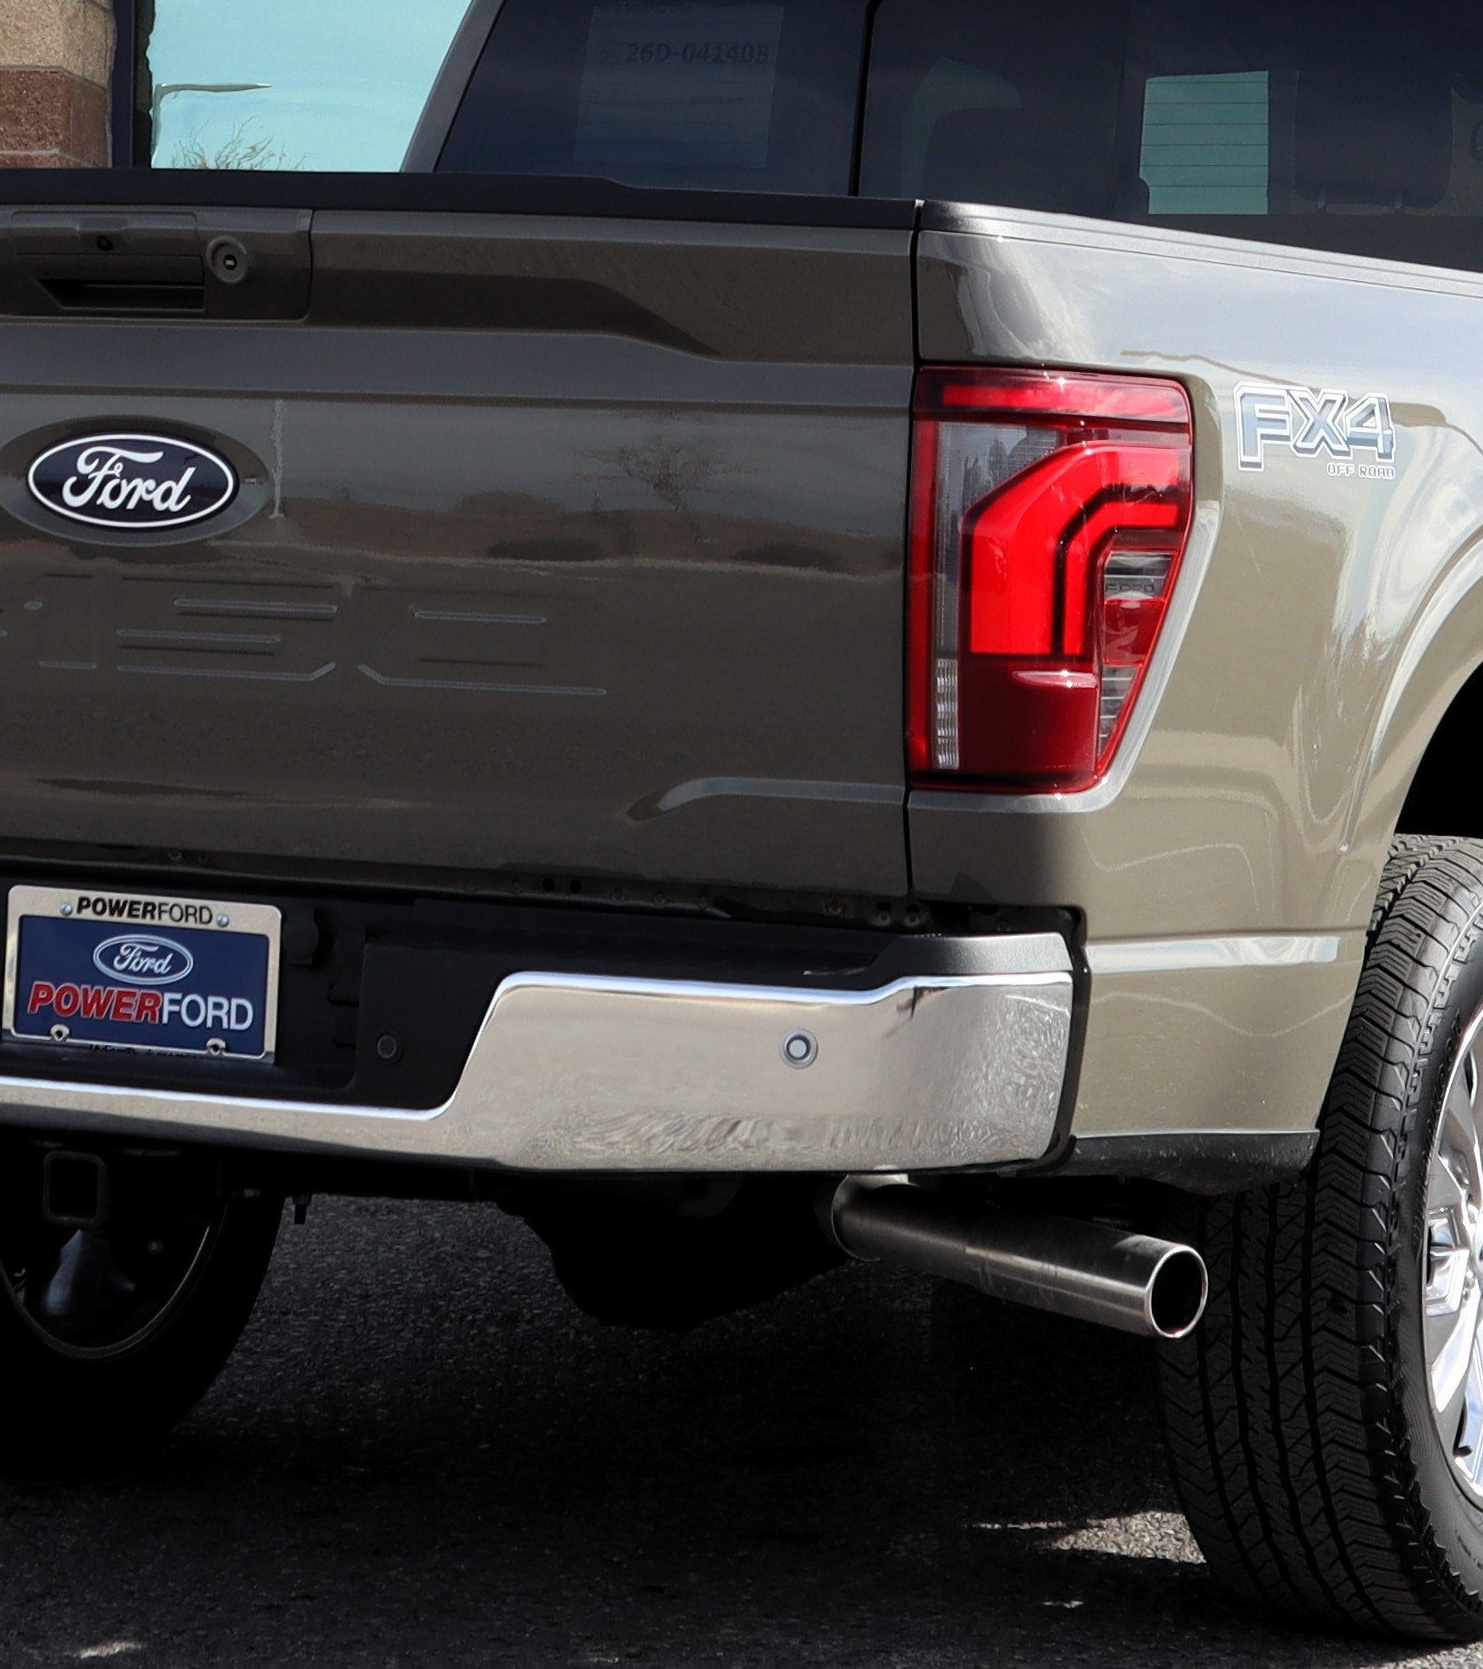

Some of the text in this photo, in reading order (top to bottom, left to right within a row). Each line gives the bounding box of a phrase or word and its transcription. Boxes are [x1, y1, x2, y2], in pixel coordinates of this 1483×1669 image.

[1233, 381, 1396, 472] FX4
[62, 445, 197, 513] Ford
[1327, 461, 1396, 480] OFF ROAD
[76, 896, 214, 925] POWERFORD
[113, 946, 172, 975] Ford
[27, 981, 255, 1031] POWERFORD
